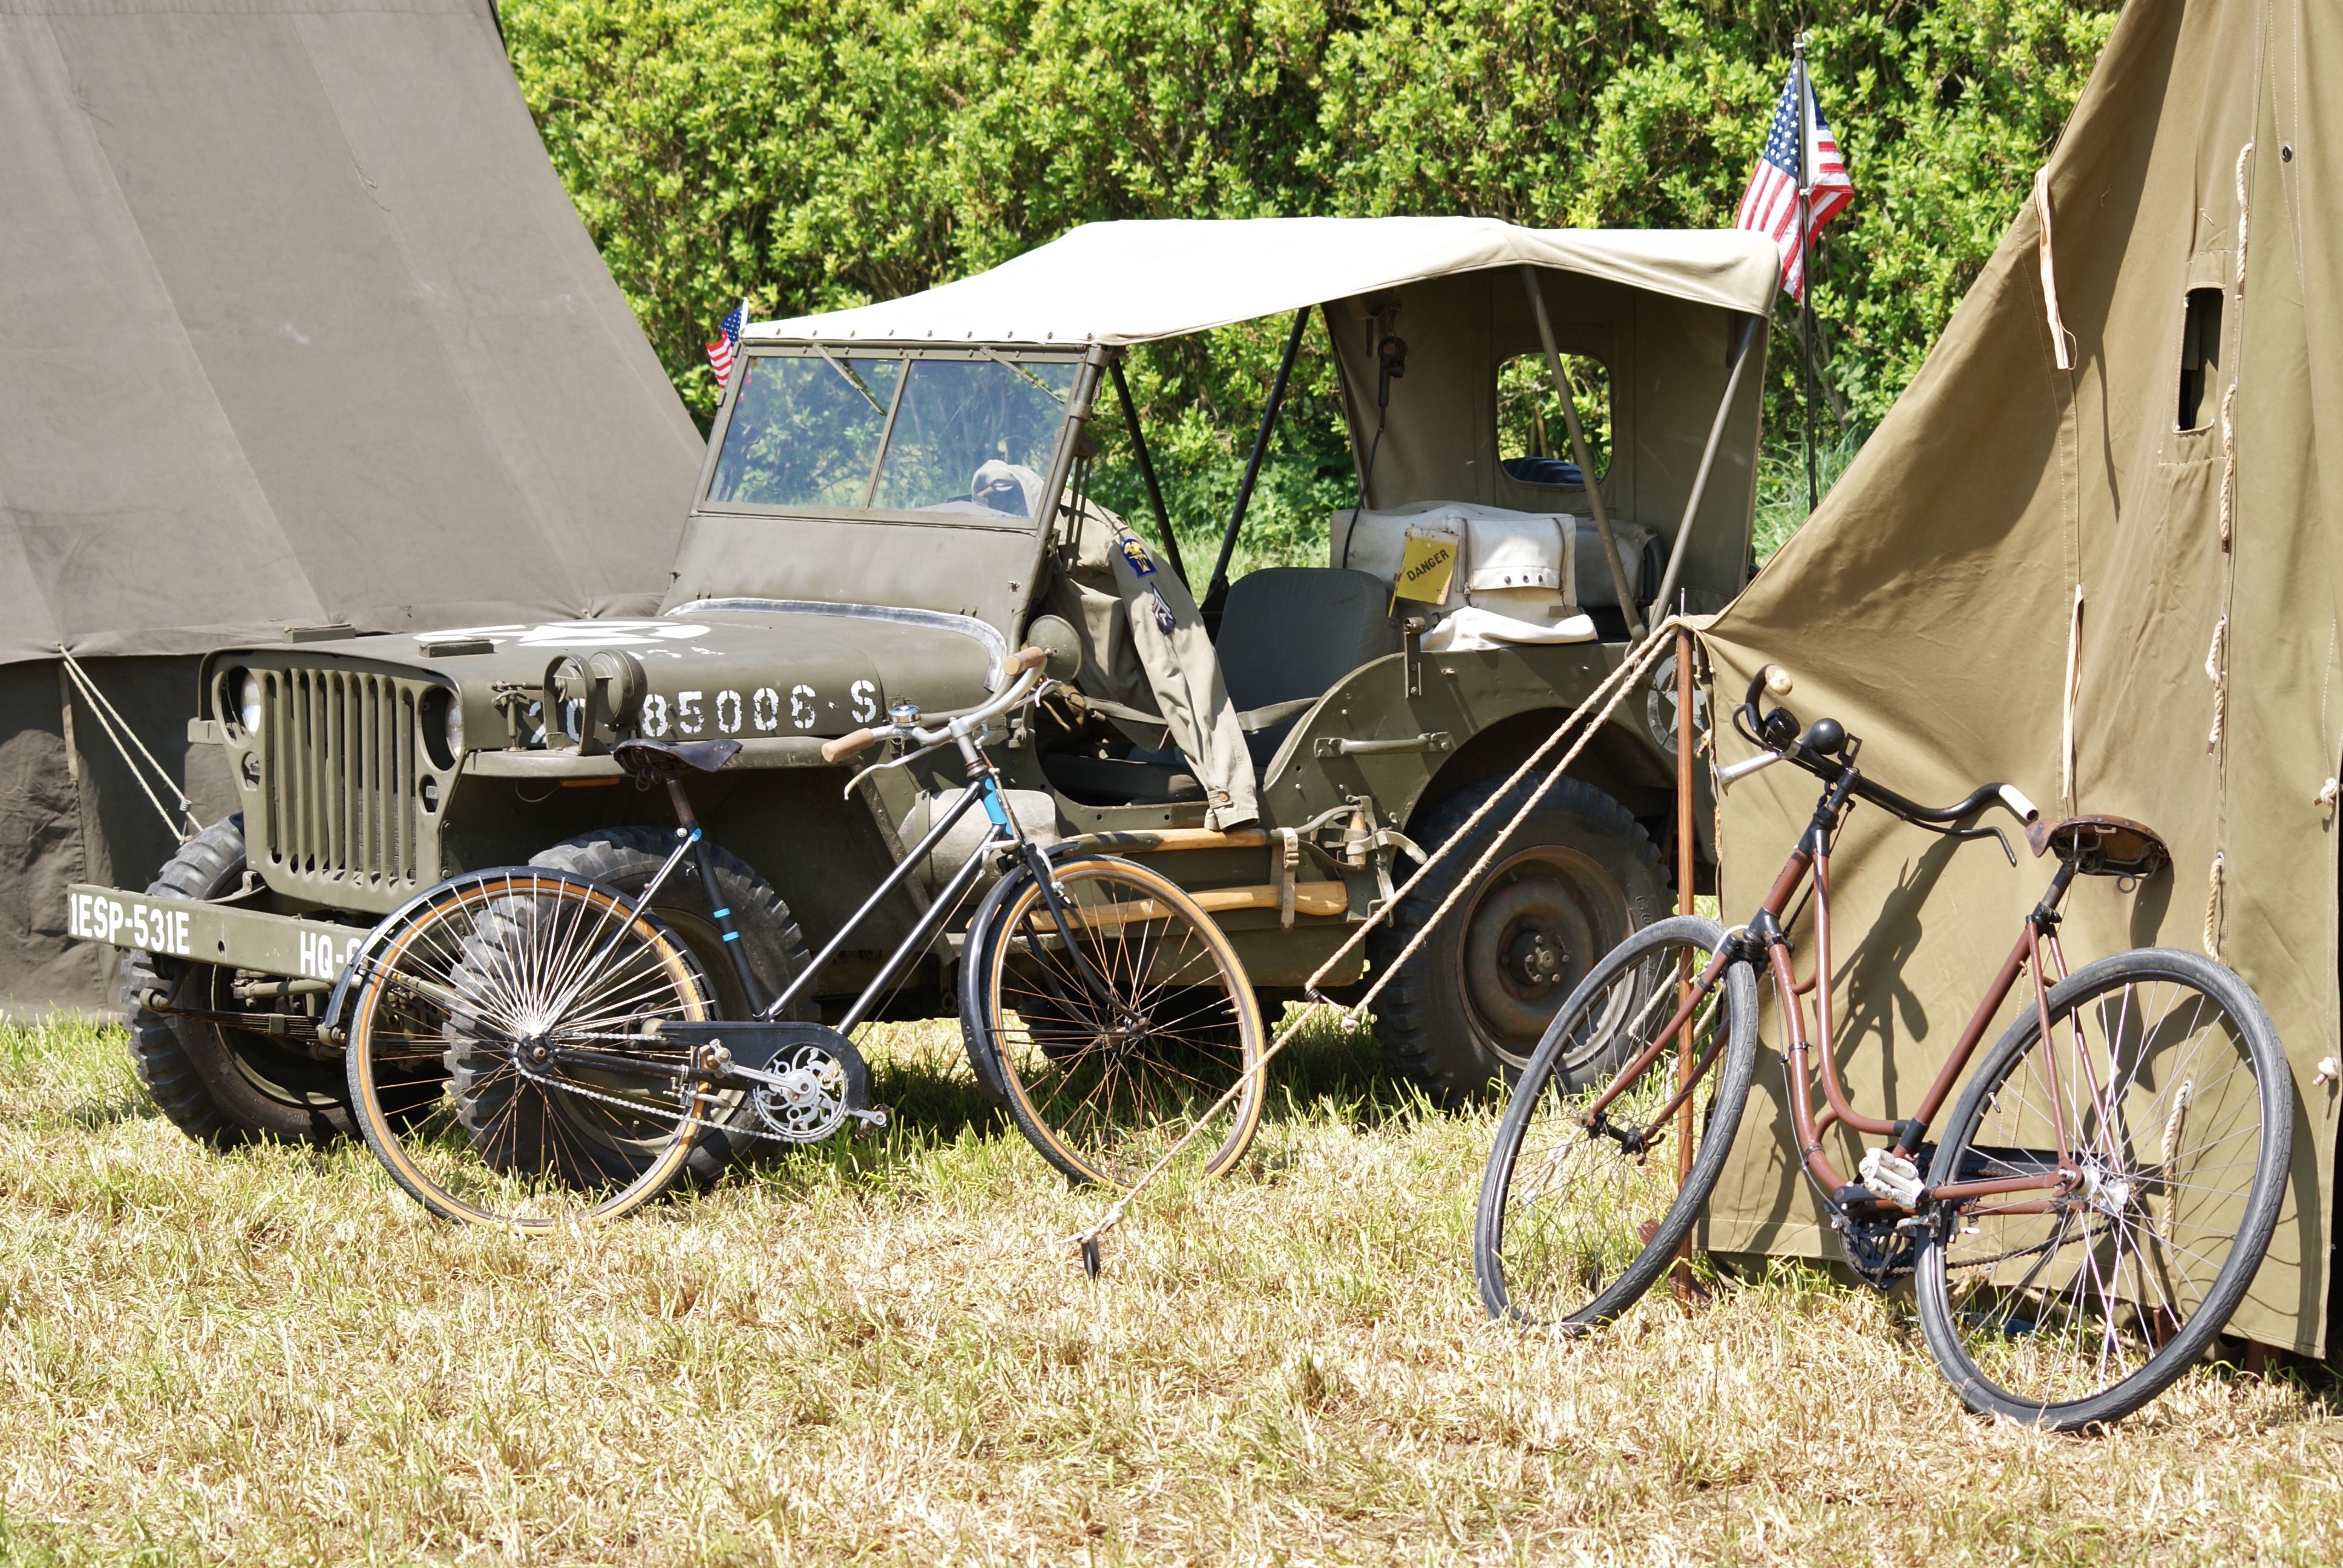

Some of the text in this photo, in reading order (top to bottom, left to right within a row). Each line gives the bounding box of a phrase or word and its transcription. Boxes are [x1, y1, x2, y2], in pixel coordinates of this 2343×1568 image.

[1406, 549, 1449, 581] DANGER
[1158, 881, 1190, 906] MICHELIN
[70, 893, 190, 955] 1ESP-531E
